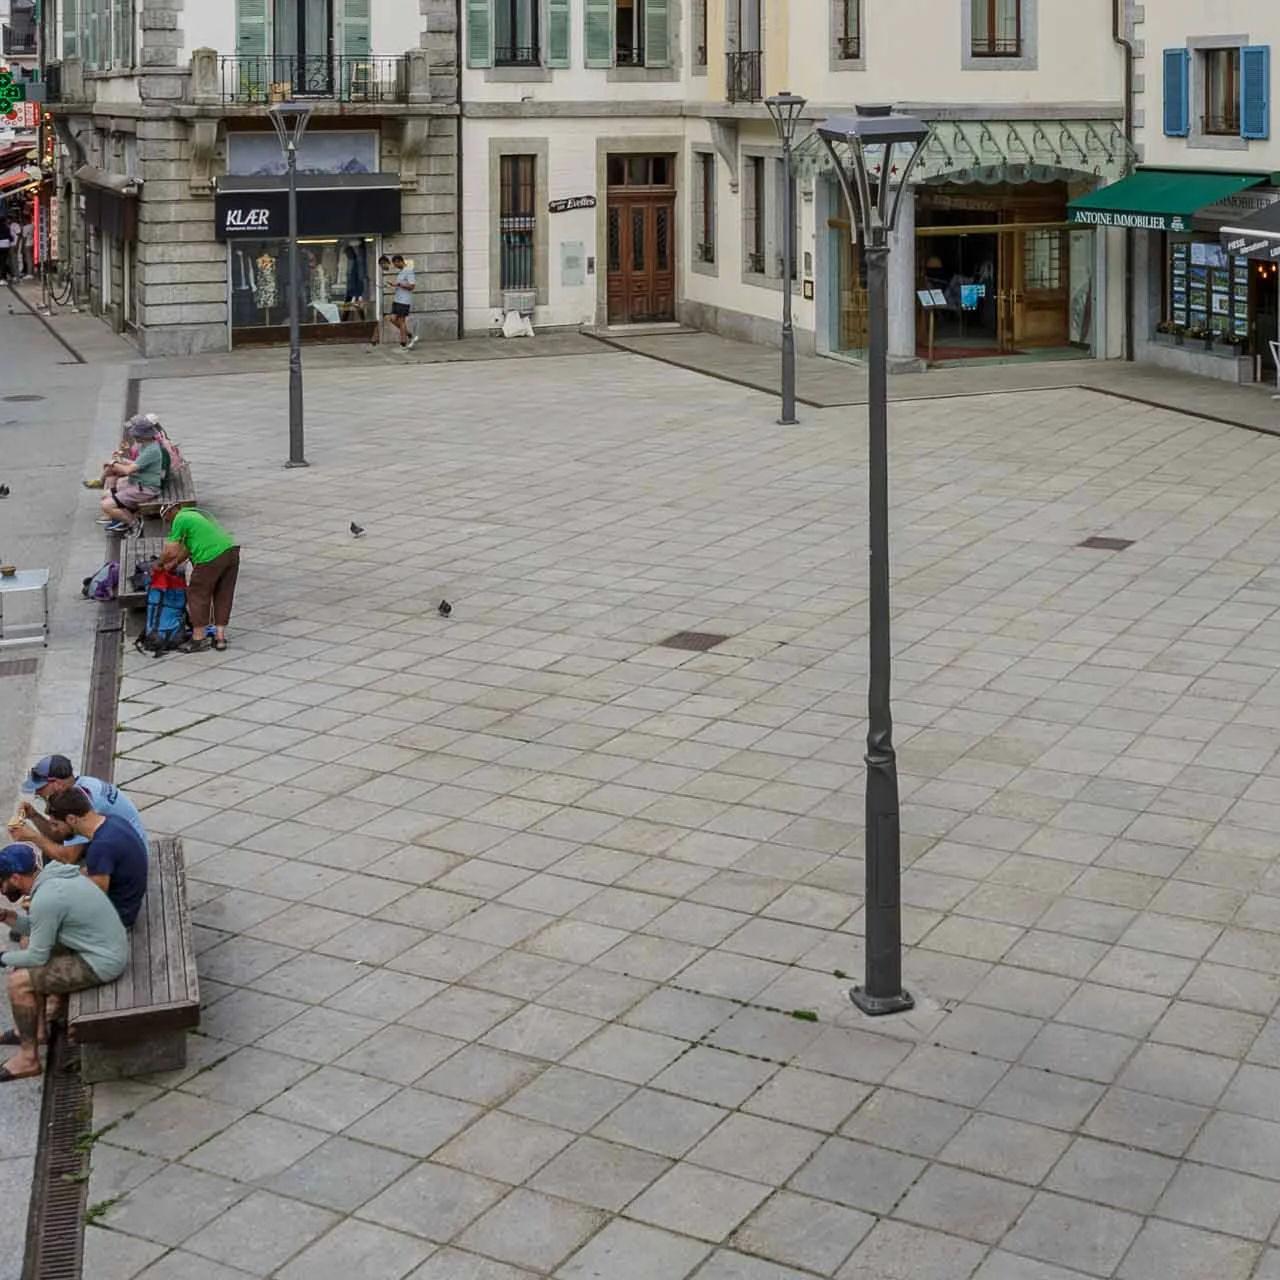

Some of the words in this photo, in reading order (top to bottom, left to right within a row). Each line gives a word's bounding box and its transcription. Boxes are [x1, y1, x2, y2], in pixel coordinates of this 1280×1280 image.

[226, 208, 270, 226] KLÆR
[1074, 211, 1113, 225] ANTOINE
[1113, 212, 1166, 229] IMMOBILIER
